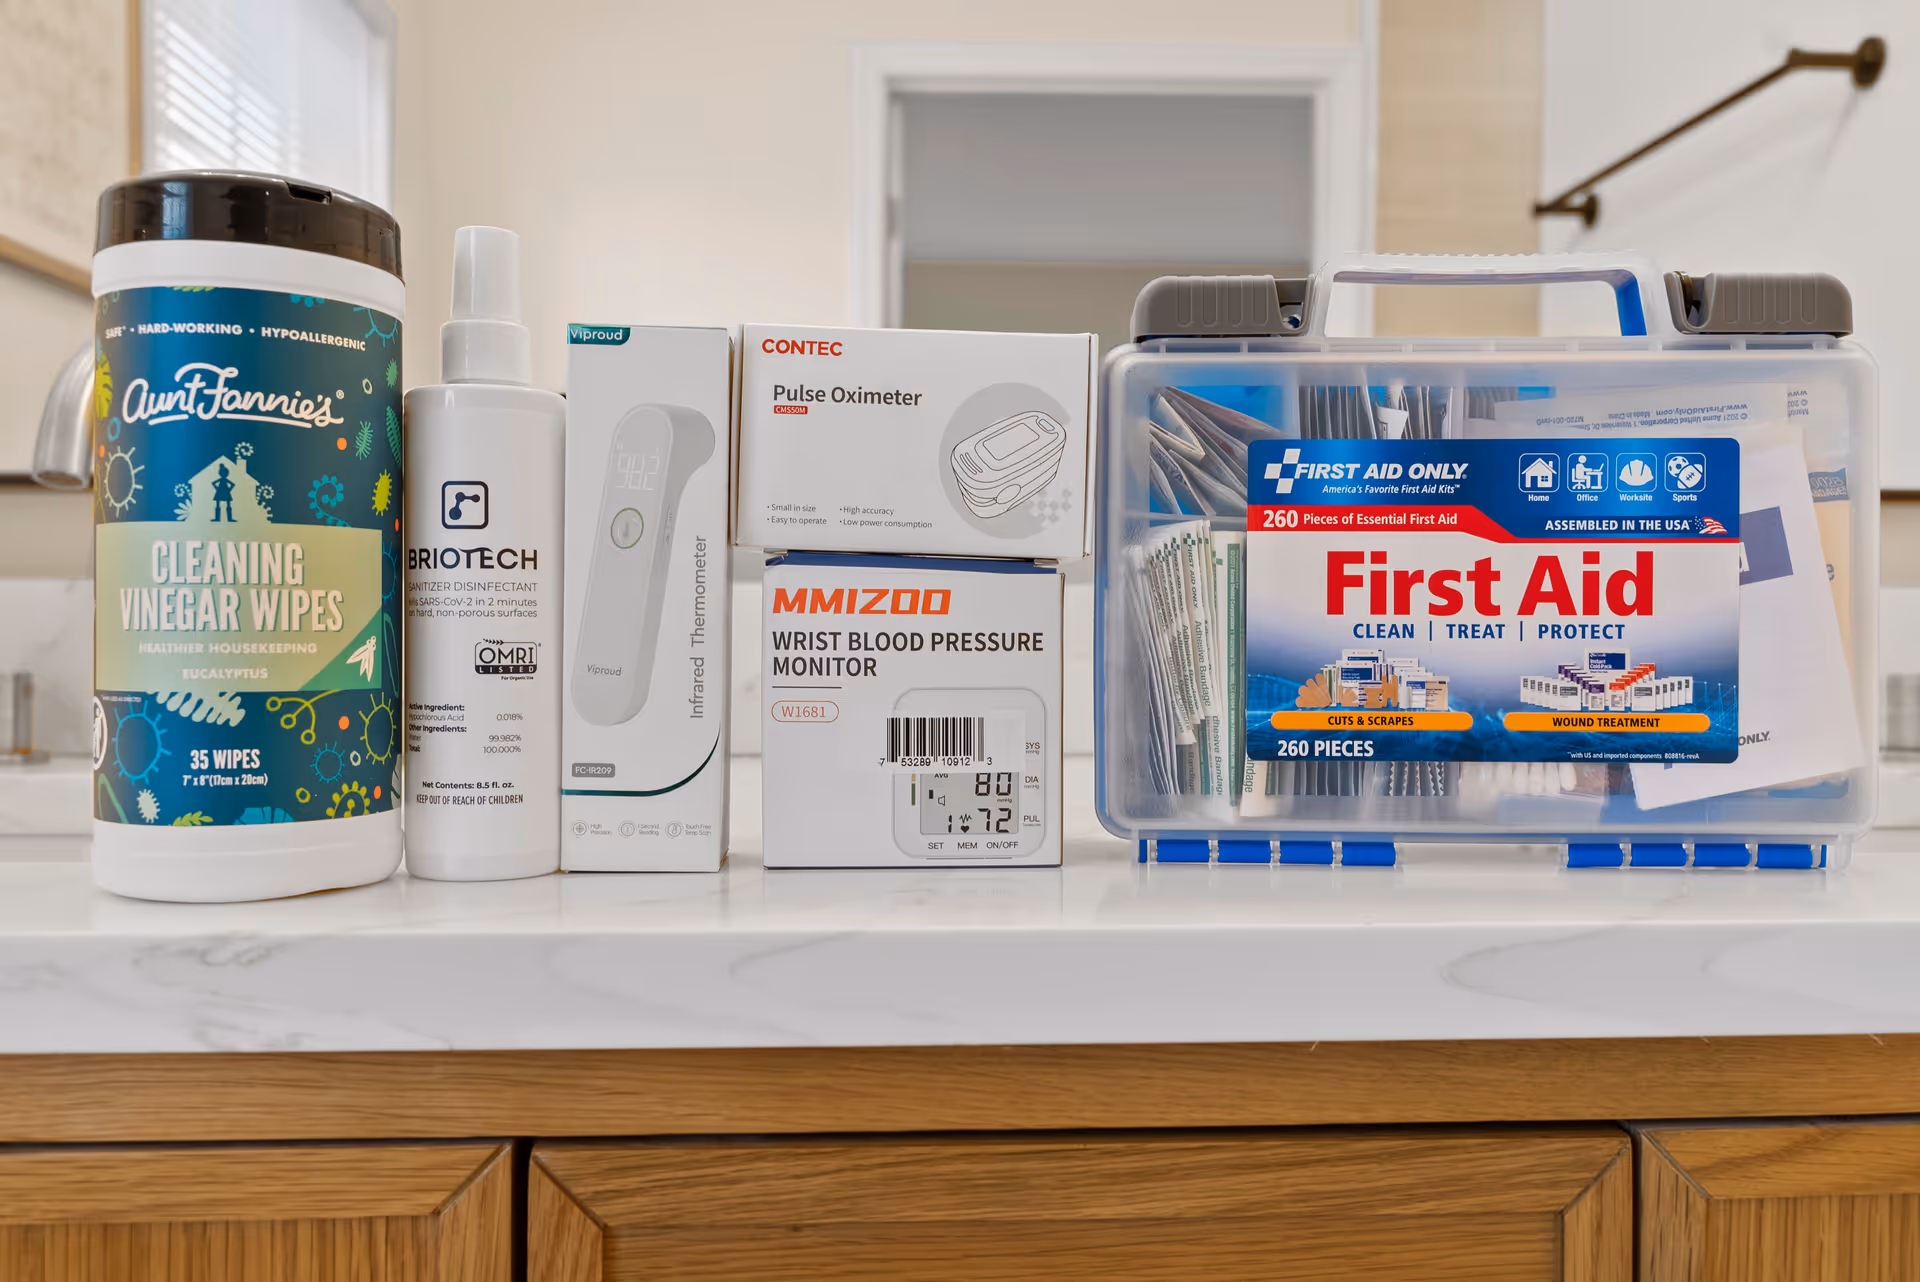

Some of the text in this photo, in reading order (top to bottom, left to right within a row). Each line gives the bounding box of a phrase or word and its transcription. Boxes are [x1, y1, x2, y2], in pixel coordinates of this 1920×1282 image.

[138, 322, 242, 336] HARD-WORKING
[261, 326, 366, 351] HYPOALLERGENIC
[570, 328, 623, 341] Viproud
[762, 338, 843, 356] CONTEC
[122, 373, 206, 424] Aunt
[773, 384, 923, 406] Pulse Oximeter
[776, 406, 806, 414] CMS50M
[1656, 404, 1748, 416] www.FirstAidOnly.com
[1680, 416, 1701, 424] United
[1723, 413, 1739, 422] 2021
[1294, 463, 1360, 480] FIRST
[1363, 463, 1404, 480] AID
[1322, 484, 1362, 494] America's
[1365, 485, 1399, 494] Favorite
[1400, 485, 1420, 494] First
[1420, 485, 1436, 494] Aid
[1528, 494, 1550, 502] Home
[1576, 494, 1598, 502] Office
[1619, 494, 1652, 502] Worksite
[1672, 494, 1698, 502] Sports
[771, 503, 816, 513] Small in size
[843, 505, 894, 517] High accuracy
[771, 516, 827, 527] Easy to operate
[843, 518, 932, 530] Low power consumption
[1263, 510, 1458, 528] 260 Pieces of Essential First Aid
[1545, 520, 1618, 530] ASSEMBLED
[1622, 520, 1635, 530] IN
[1638, 520, 1662, 530] THE
[152, 540, 305, 586] CLEANING
[408, 546, 538, 570] BRIOTECH
[408, 582, 538, 592] SANITIZER DISINFECTANT
[1327, 551, 1654, 616] First Aid
[419, 597, 472, 606] SARS-CoV-2
[476, 597, 485, 606] in
[488, 598, 494, 606] 2
[497, 597, 538, 607] minutes
[772, 588, 952, 614] MMIZOO
[120, 587, 344, 633] VINEGAR WIPES
[416, 608, 538, 618] hard, non-porous surfaces
[689, 535, 706, 718] Infrared Thermometer
[1352, 623, 1625, 640] CLEAN TREAT PROTECT
[772, 631, 1044, 652] WRIST BLOOD PRESSURE
[138, 642, 318, 655] HEALTHIER HOUSEKEEPING
[479, 647, 534, 664] OMRI
[772, 656, 878, 677] MONITOR
[1195, 620, 1205, 663] Adhesive
[1200, 666, 1212, 707] Bandage
[182, 668, 268, 680] EUCALYPTUS
[586, 664, 622, 676] Viproud
[409, 702, 465, 712] Active Ingredient:
[782, 706, 826, 718] W1681
[496, 713, 524, 722] 0.018%
[1328, 716, 1414, 726] CUTS & SCRAPES
[1552, 718, 1660, 728] WOUND TREATMENT
[422, 724, 467, 734] Ingredients:
[1212, 716, 1221, 753] dhesive
[488, 734, 522, 742] 99.982%
[483, 745, 522, 754] 100.000%
[1278, 740, 1374, 757] 260 PIECES
[190, 749, 261, 770] 35 WIPES
[880, 757, 992, 767] 7 53289 10912 3
[1604, 752, 1628, 760] imported
[1664, 752, 1700, 760] 808816-revA
[575, 766, 612, 776] FC-IR209
[193, 777, 198, 786] x
[234, 777, 240, 786] x
[240, 774, 268, 787] 20cm)
[422, 780, 434, 789] Net
[435, 781, 474, 790] Contents:
[476, 781, 490, 789] 8.5
[492, 781, 500, 789] fl.
[975, 772, 1012, 796] 80
[1024, 776, 1039, 784] DIA
[416, 794, 524, 805] KEEP OUT OF REACH OF CHILDREN
[978, 808, 1012, 832] 72
[986, 841, 1019, 849] ON/OFF
